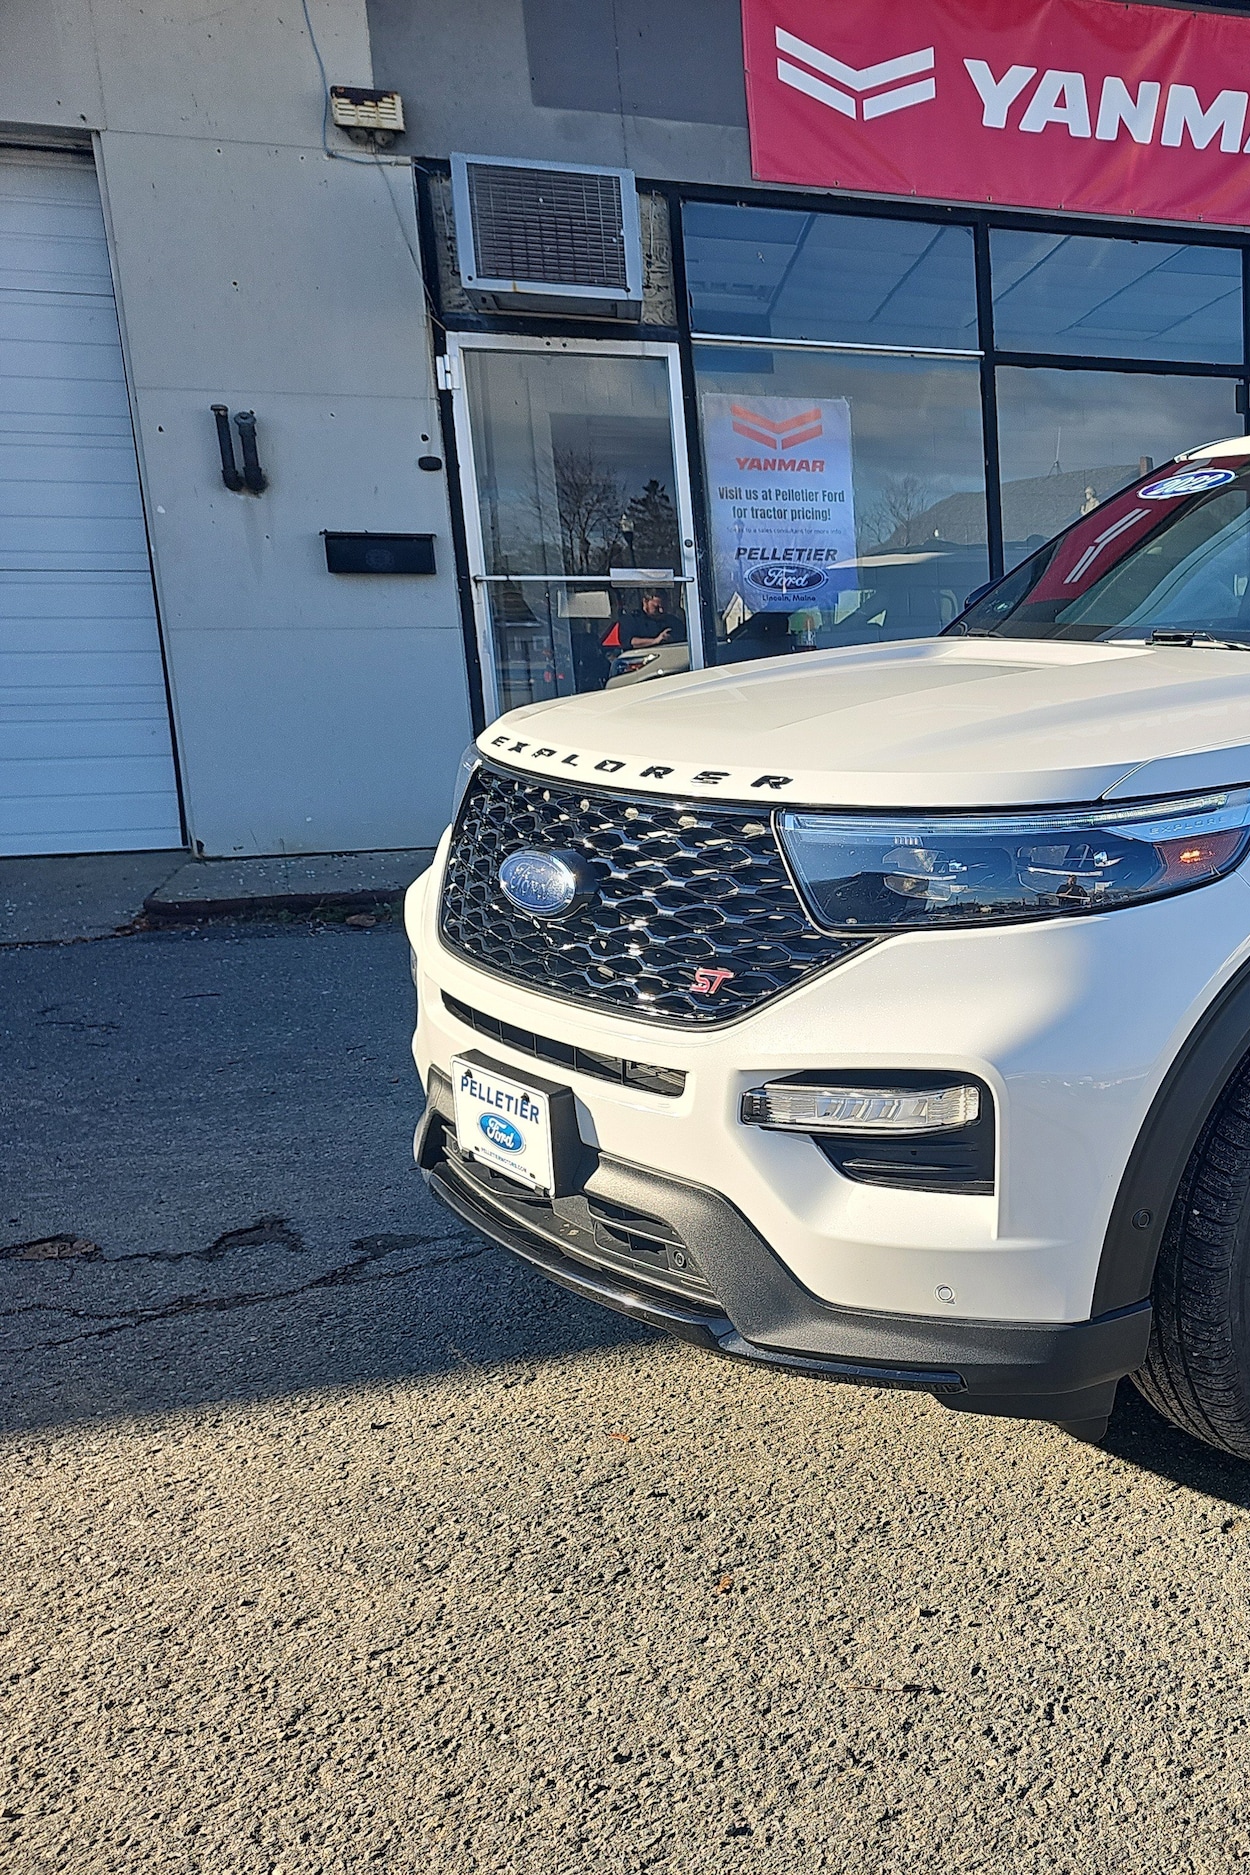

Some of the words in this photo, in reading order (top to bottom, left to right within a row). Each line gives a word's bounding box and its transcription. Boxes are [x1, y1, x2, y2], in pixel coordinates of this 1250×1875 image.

[735, 457, 826, 473] YANMAR
[718, 486, 743, 500] Visit
[745, 489, 759, 501] us
[761, 488, 773, 501] at
[775, 489, 819, 502] Pelletier
[821, 490, 845, 503] Ford
[732, 505, 748, 519] for
[751, 506, 788, 520] tractor
[790, 507, 831, 522] pricing!
[734, 547, 838, 561] PELLETIER
[763, 567, 809, 587] Ford
[762, 594, 791, 602] Lincoln,
[792, 594, 817, 602] Maine
[490, 735, 794, 791] EXPLORER
[1149, 815, 1238, 836] EXPLORE
[510, 861, 554, 900] Ford
[689, 968, 735, 995] ST
[460, 1074, 540, 1125] PELLETIER
[486, 1117, 516, 1149] Ford
